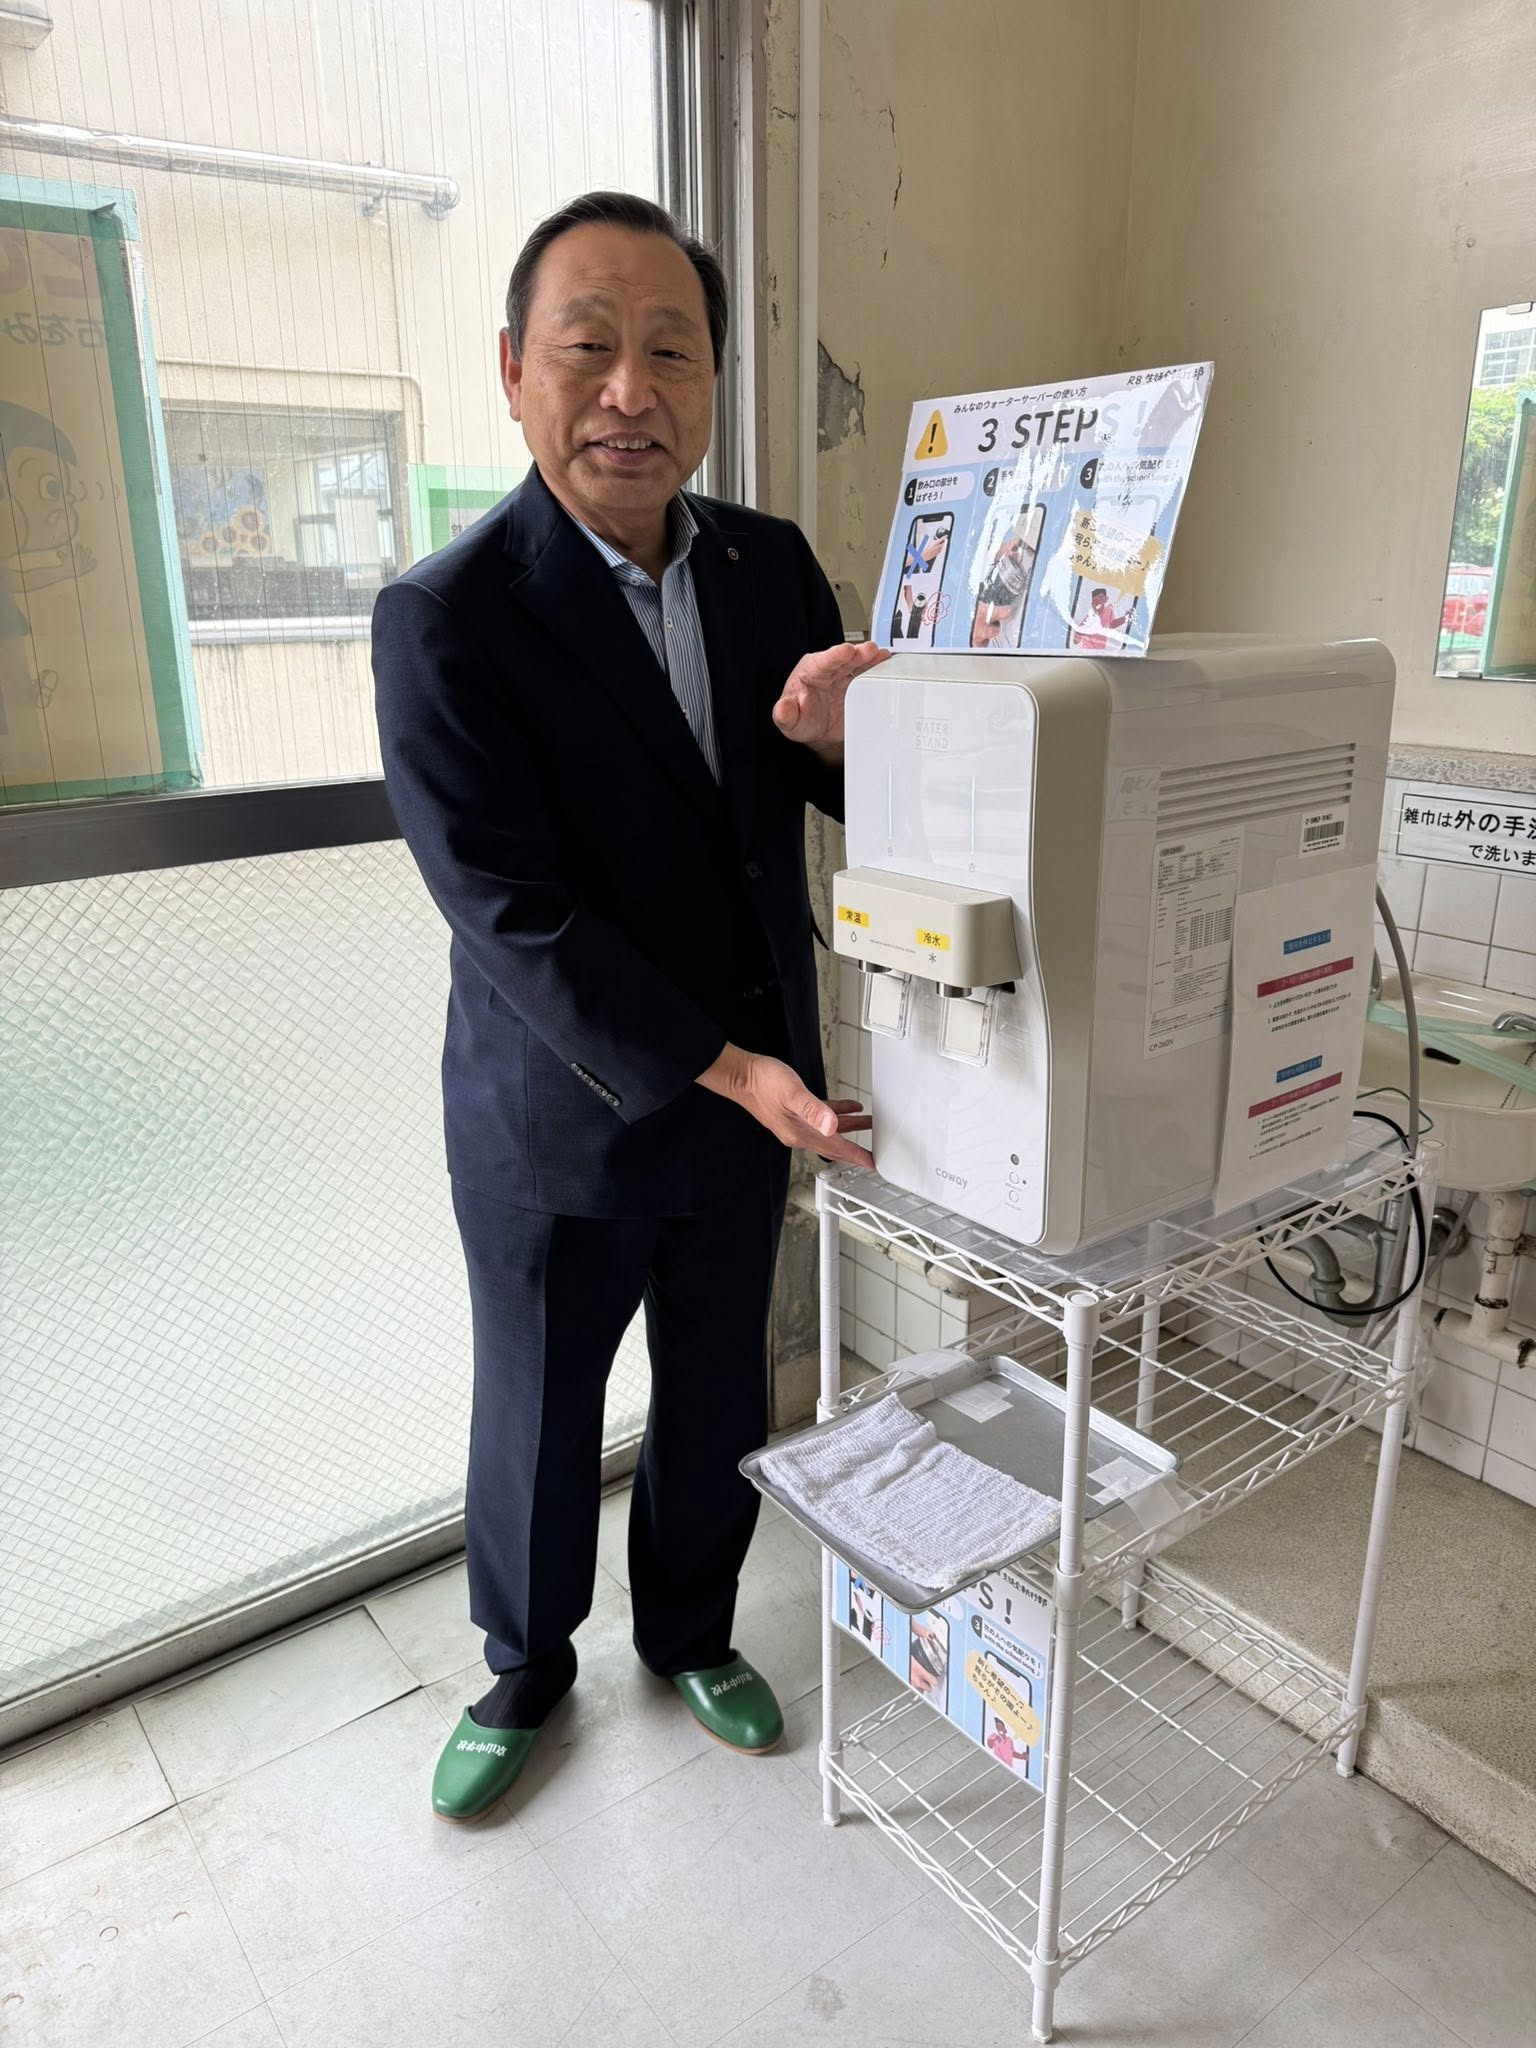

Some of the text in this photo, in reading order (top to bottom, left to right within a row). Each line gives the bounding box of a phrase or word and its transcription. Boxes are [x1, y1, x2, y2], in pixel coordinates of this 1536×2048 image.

[953, 386, 1088, 414] みんなのウォーターサーバーの使い方
[978, 418, 999, 452] 3
[987, 475, 995, 488] 2
[1084, 467, 1093, 480] 3
[923, 932, 941, 947] 冷水
[935, 1167, 968, 1189] coway
